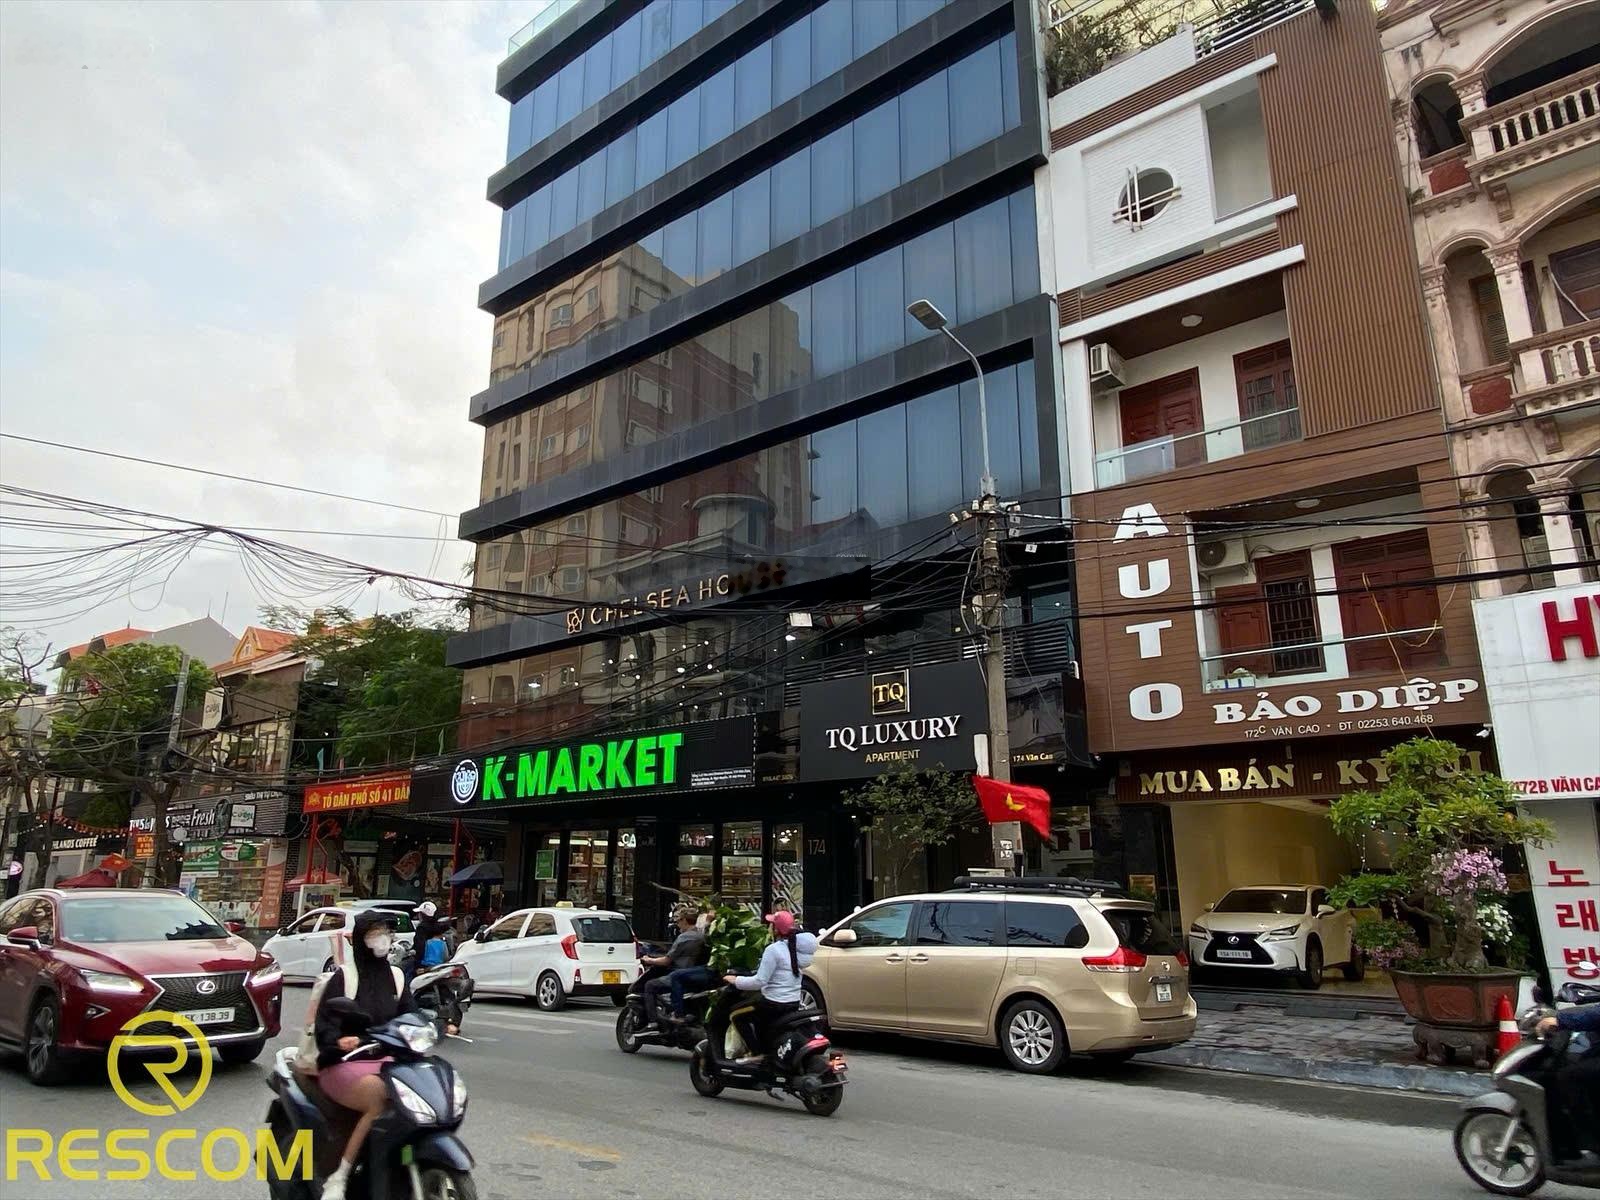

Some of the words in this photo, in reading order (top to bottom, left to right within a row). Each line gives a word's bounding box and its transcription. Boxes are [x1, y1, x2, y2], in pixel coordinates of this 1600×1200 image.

[590, 585, 691, 625] CHELSEA
[1112, 502, 1184, 721] AUTO
[1542, 595, 1600, 662] H
[873, 682, 904, 703] TQ
[1212, 691, 1322, 724] BẢO
[1336, 678, 1479, 714] DIỆP
[825, 726, 858, 751] TQ
[860, 714, 961, 746] LUXURY
[1298, 724, 1320, 734] CAO
[1339, 721, 1352, 731] ĐT
[483, 733, 684, 800] K-MARKET
[865, 749, 921, 763] APARTMENT
[1139, 770, 1213, 795] MUA
[1218, 758, 1295, 792] BÁN
[1551, 776, 1582, 793] VĂN
[351, 787, 367, 806] PHỐ
[369, 785, 382, 803] SỐ
[382, 788, 392, 802] 41
[191, 808, 216, 827] Fresh
[75, 836, 98, 848] COFFEE
[808, 839, 826, 855] 174
[1548, 860, 1600, 980] 노래방
